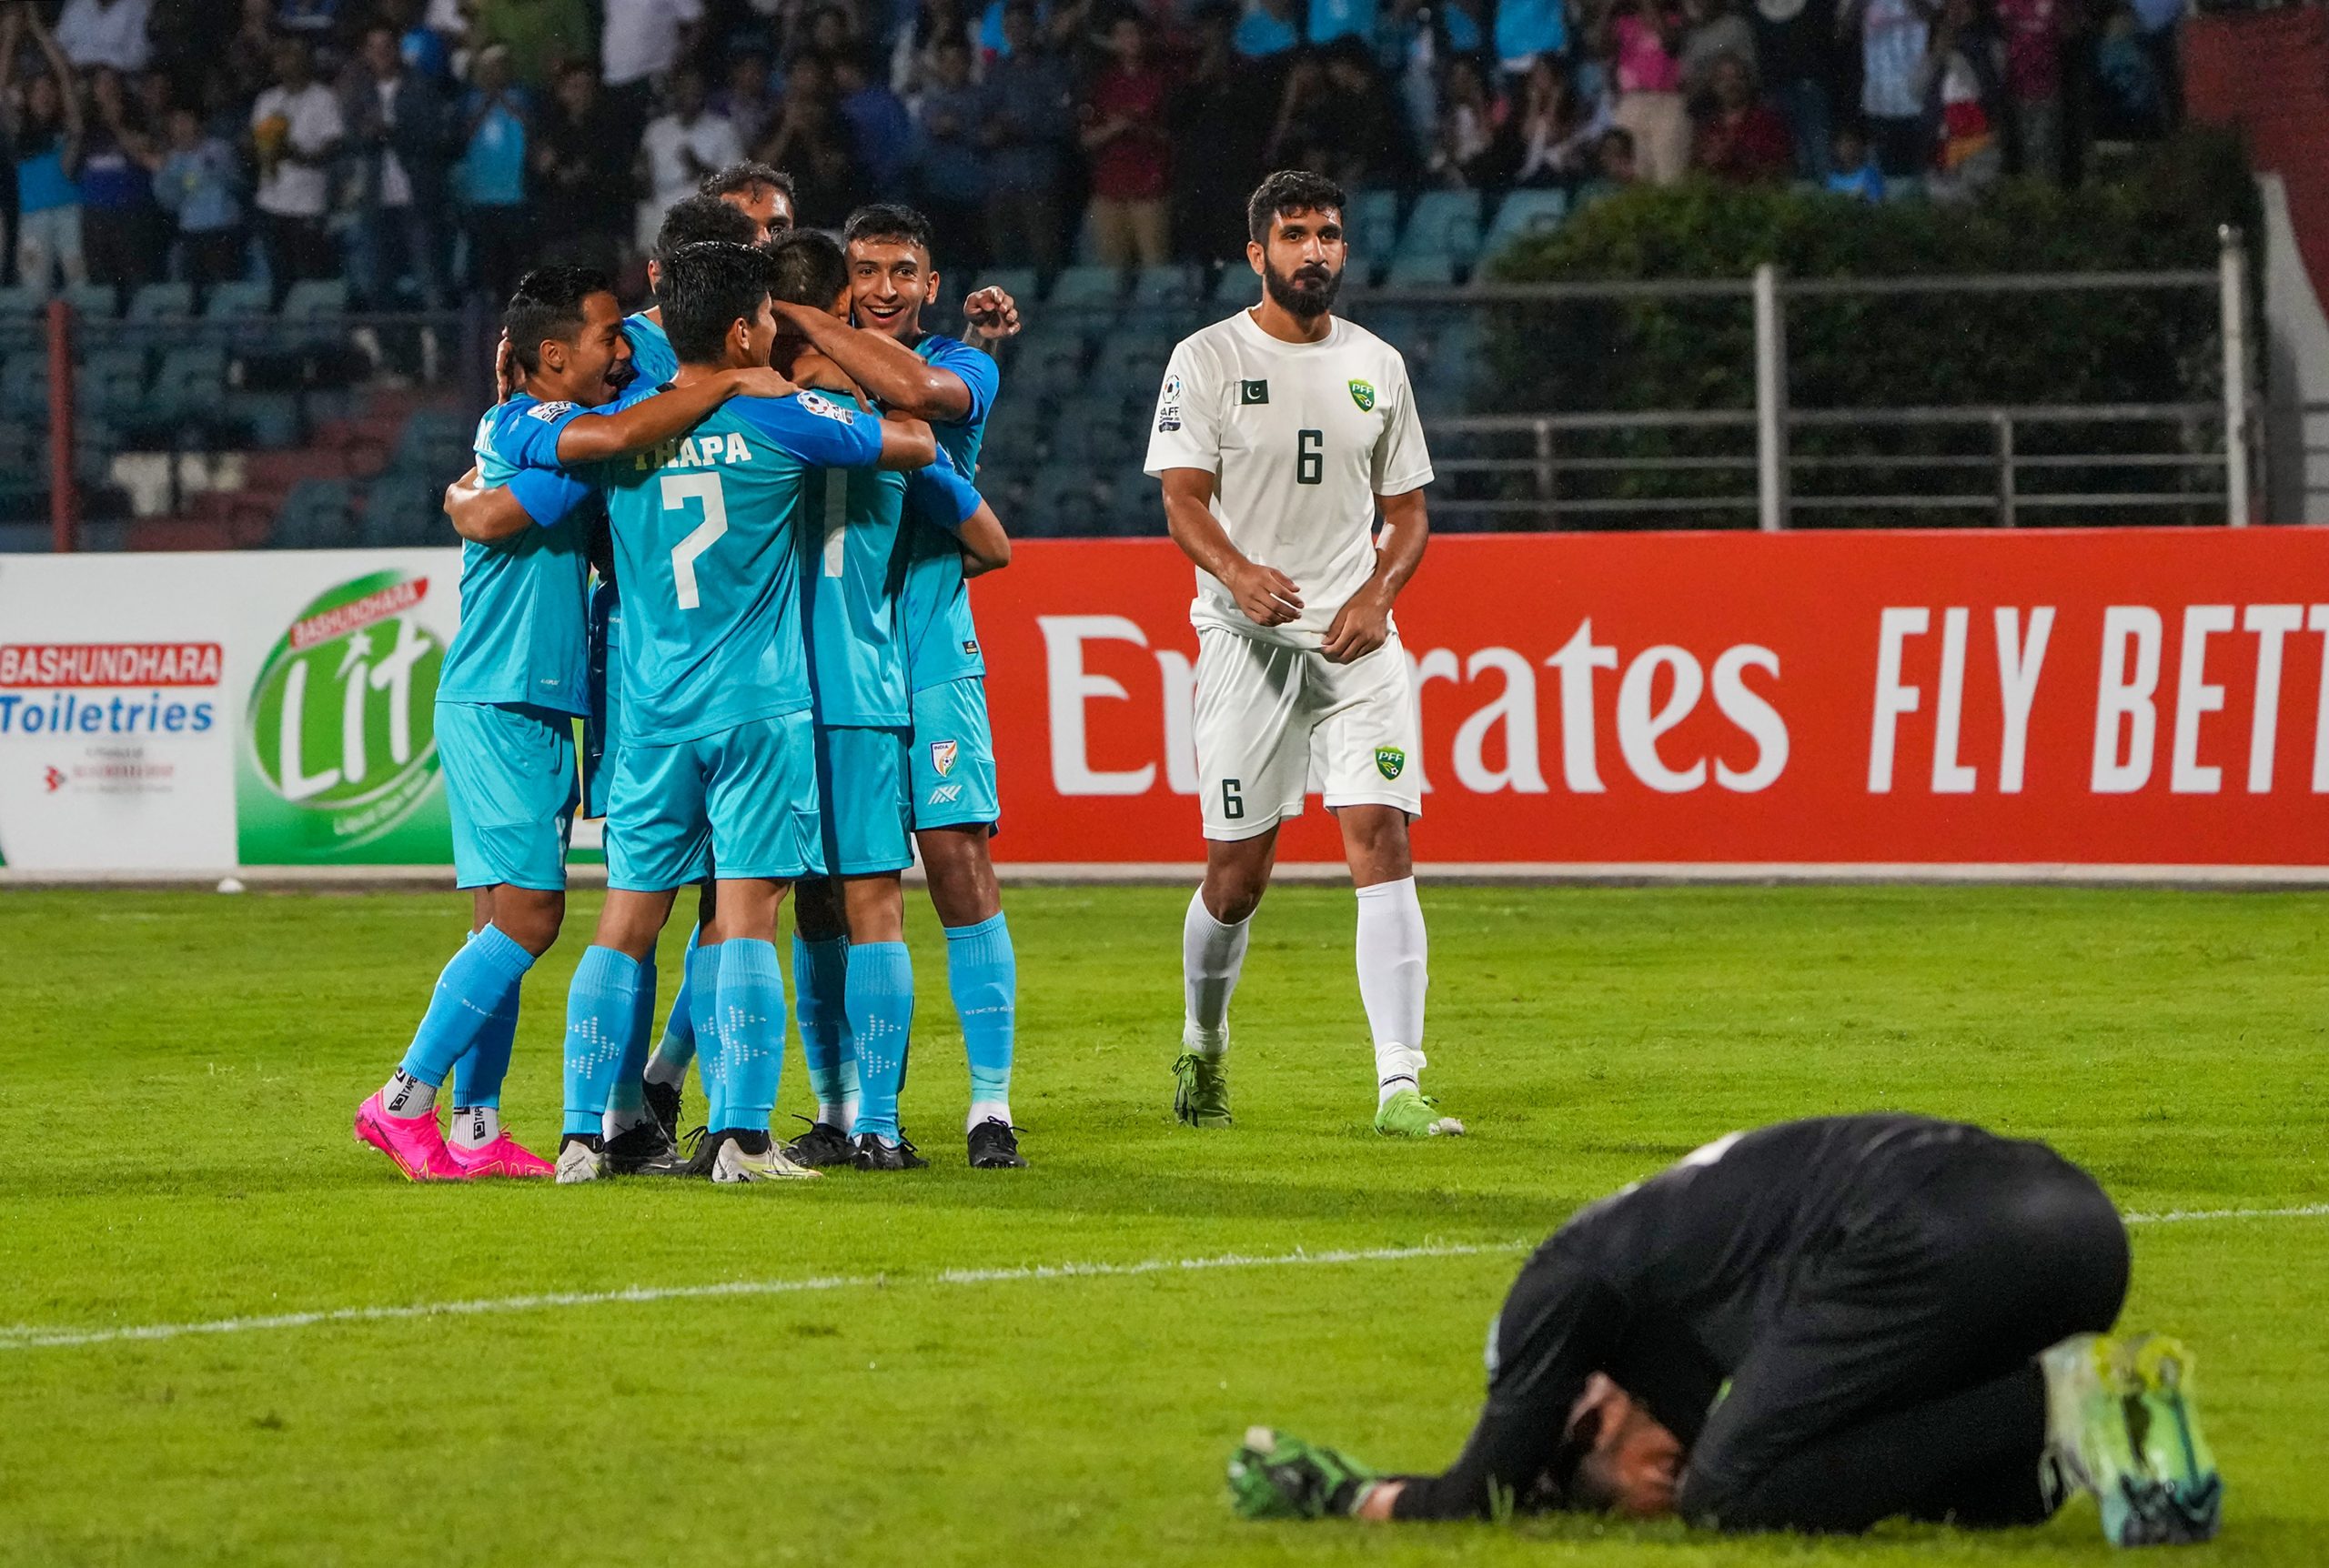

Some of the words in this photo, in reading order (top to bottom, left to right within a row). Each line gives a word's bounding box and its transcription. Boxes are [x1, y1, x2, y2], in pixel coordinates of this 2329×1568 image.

[1352, 383, 1373, 394] PFF
[1296, 428, 1323, 485] 6
[660, 472, 728, 609] 7
[0, 647, 218, 684] BASHUNDHARA
[0, 691, 213, 733] Toiletries
[1034, 614, 1790, 797] Erates
[1867, 606, 2057, 794] FLY
[1378, 751, 1403, 762] PFF
[1222, 779, 1244, 819] 6
